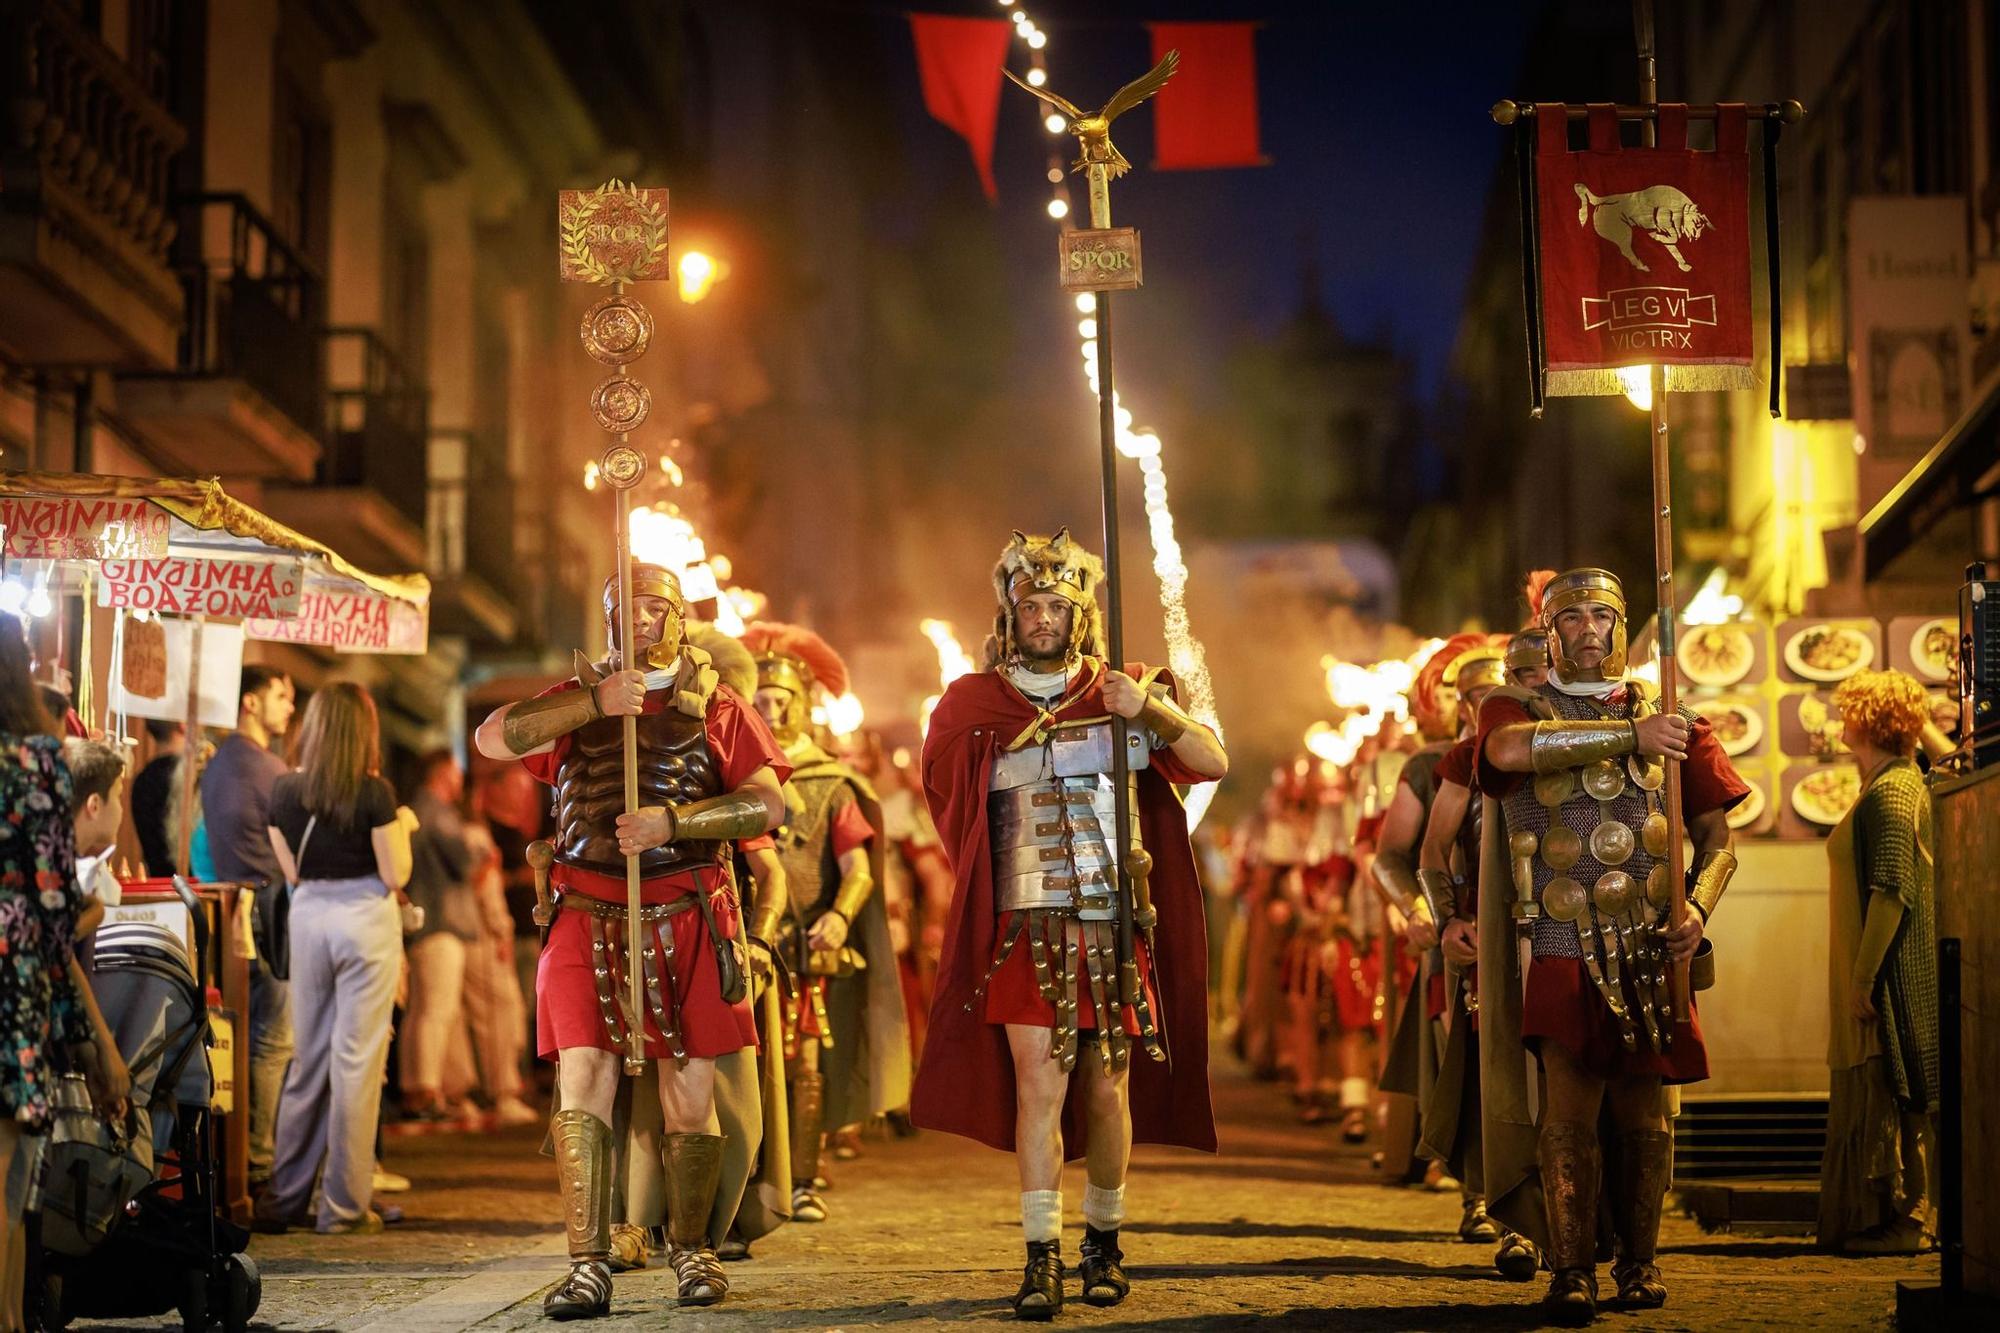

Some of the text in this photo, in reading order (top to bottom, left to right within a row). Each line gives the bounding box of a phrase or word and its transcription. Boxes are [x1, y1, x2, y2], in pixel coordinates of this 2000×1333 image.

[586, 224, 646, 244] SPQR
[1070, 250, 1132, 271] SPQR
[1612, 296, 1685, 319] LEG VI
[1611, 330, 1693, 349] VICTRIX
[1, 499, 149, 543] INJINHA
[101, 556, 278, 598] GINJINHA
[110, 580, 275, 618] BOAZONA
[301, 592, 389, 633] JINHA
